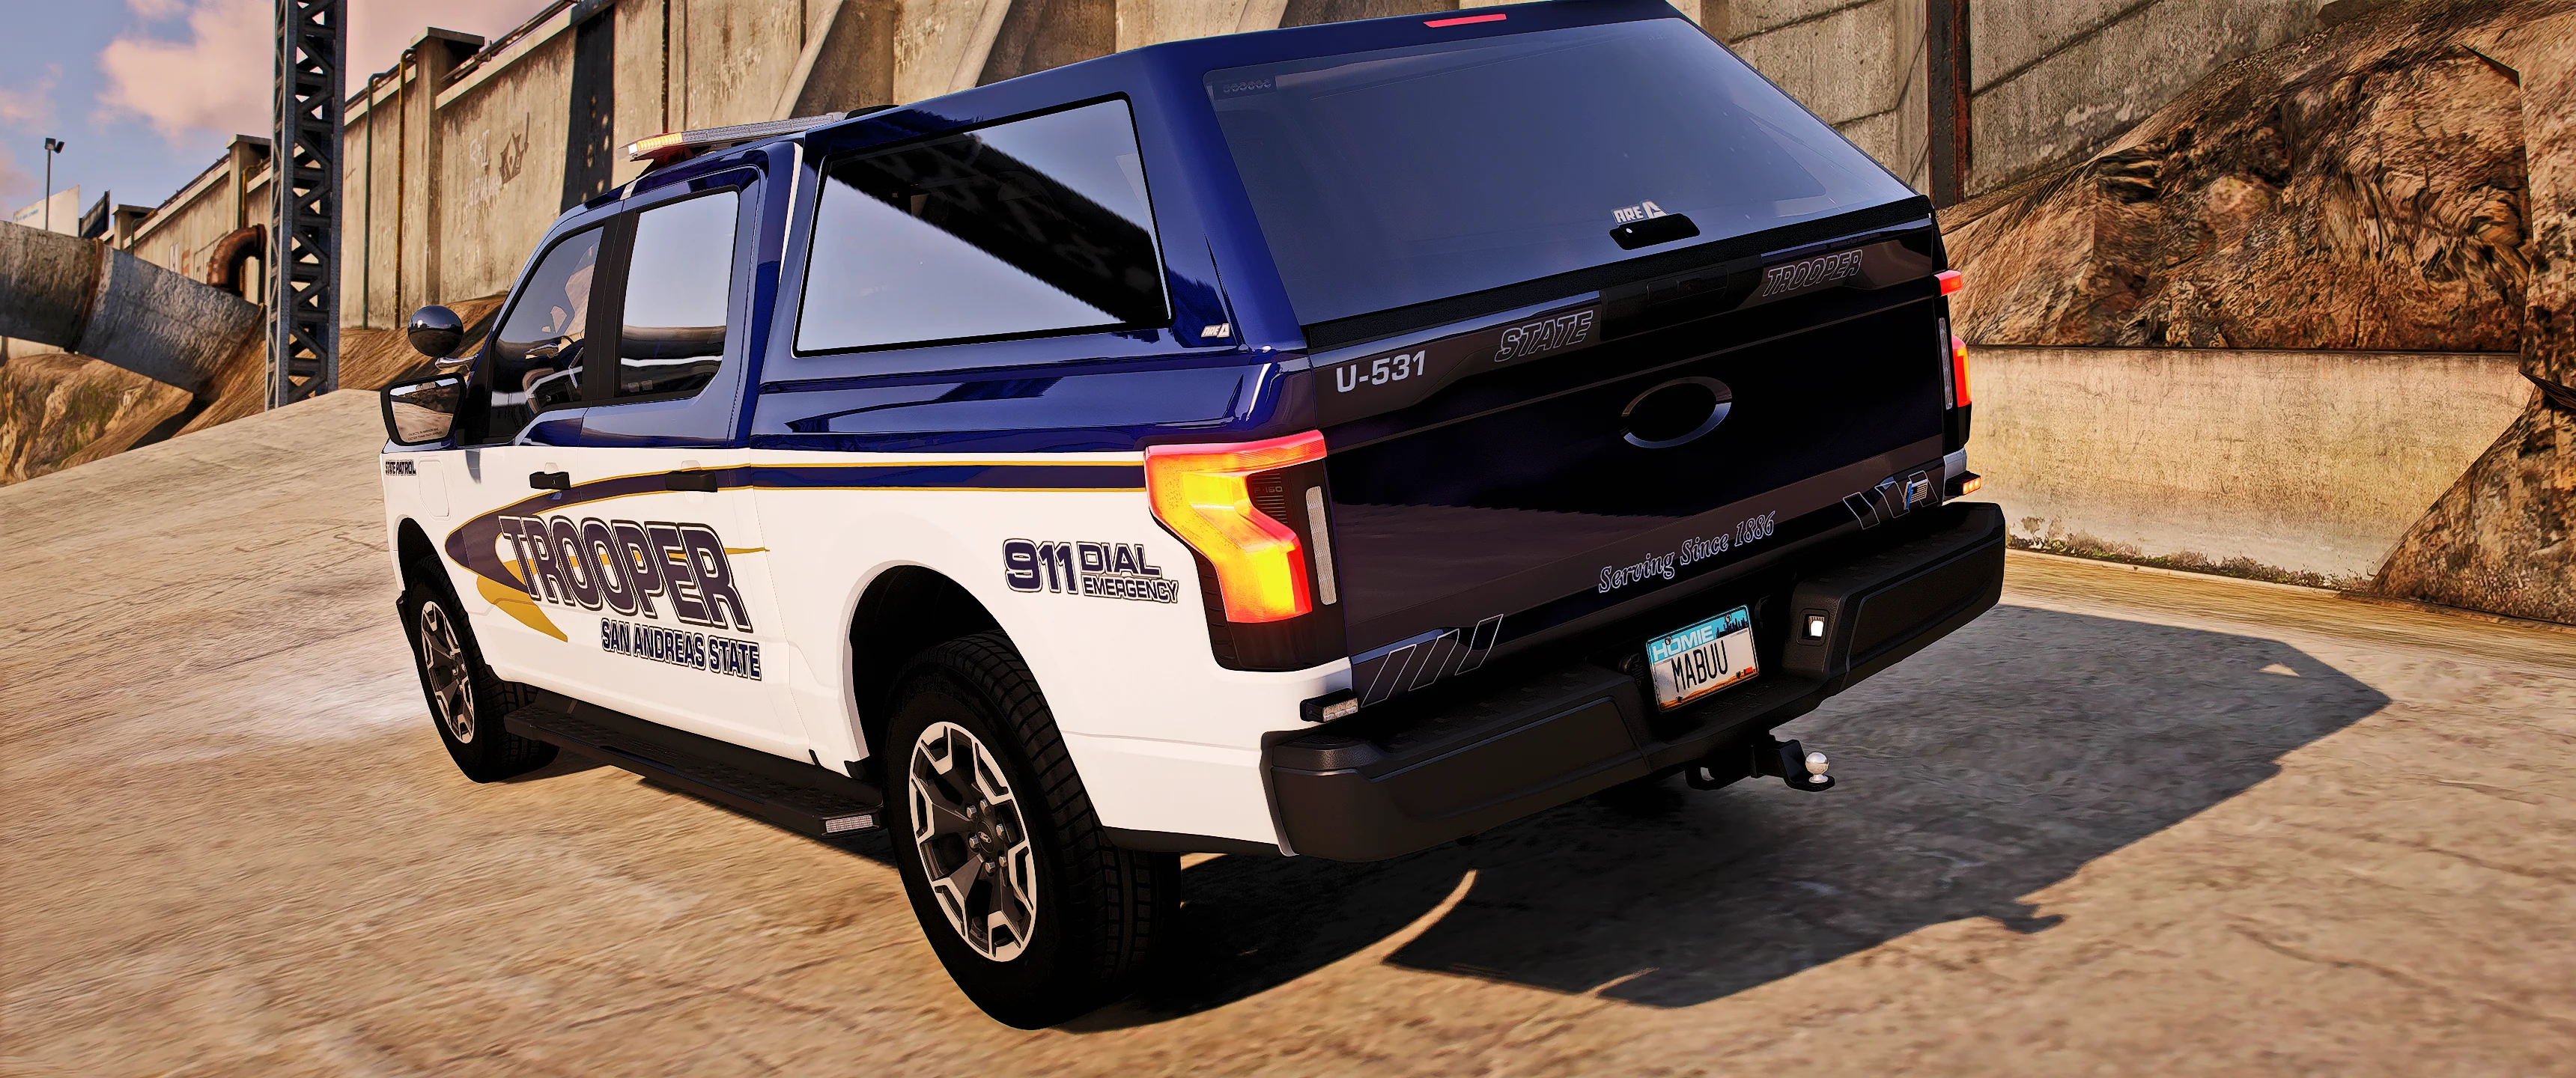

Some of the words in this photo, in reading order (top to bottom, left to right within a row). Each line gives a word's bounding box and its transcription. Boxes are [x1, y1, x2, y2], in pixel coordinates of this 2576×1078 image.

[1762, 249, 1863, 297] TROOPER
[1494, 310, 1594, 363] STATE
[1336, 350, 1426, 393] U-531
[396, 460, 417, 476] PATROL
[498, 515, 753, 633] TROOPER
[1003, 538, 1078, 595] 911
[1076, 541, 1162, 579] DIAL
[1598, 552, 1675, 593] Serving
[1680, 534, 1729, 565] Since
[1734, 511, 1775, 546] 1886
[1081, 574, 1179, 603] EMERGENCY
[601, 618, 631, 657] SAN
[634, 623, 706, 672] ANDREAS
[708, 635, 762, 681] STATE
[1652, 625, 1714, 661] HOMIE
[1671, 640, 1728, 693] MABUU
